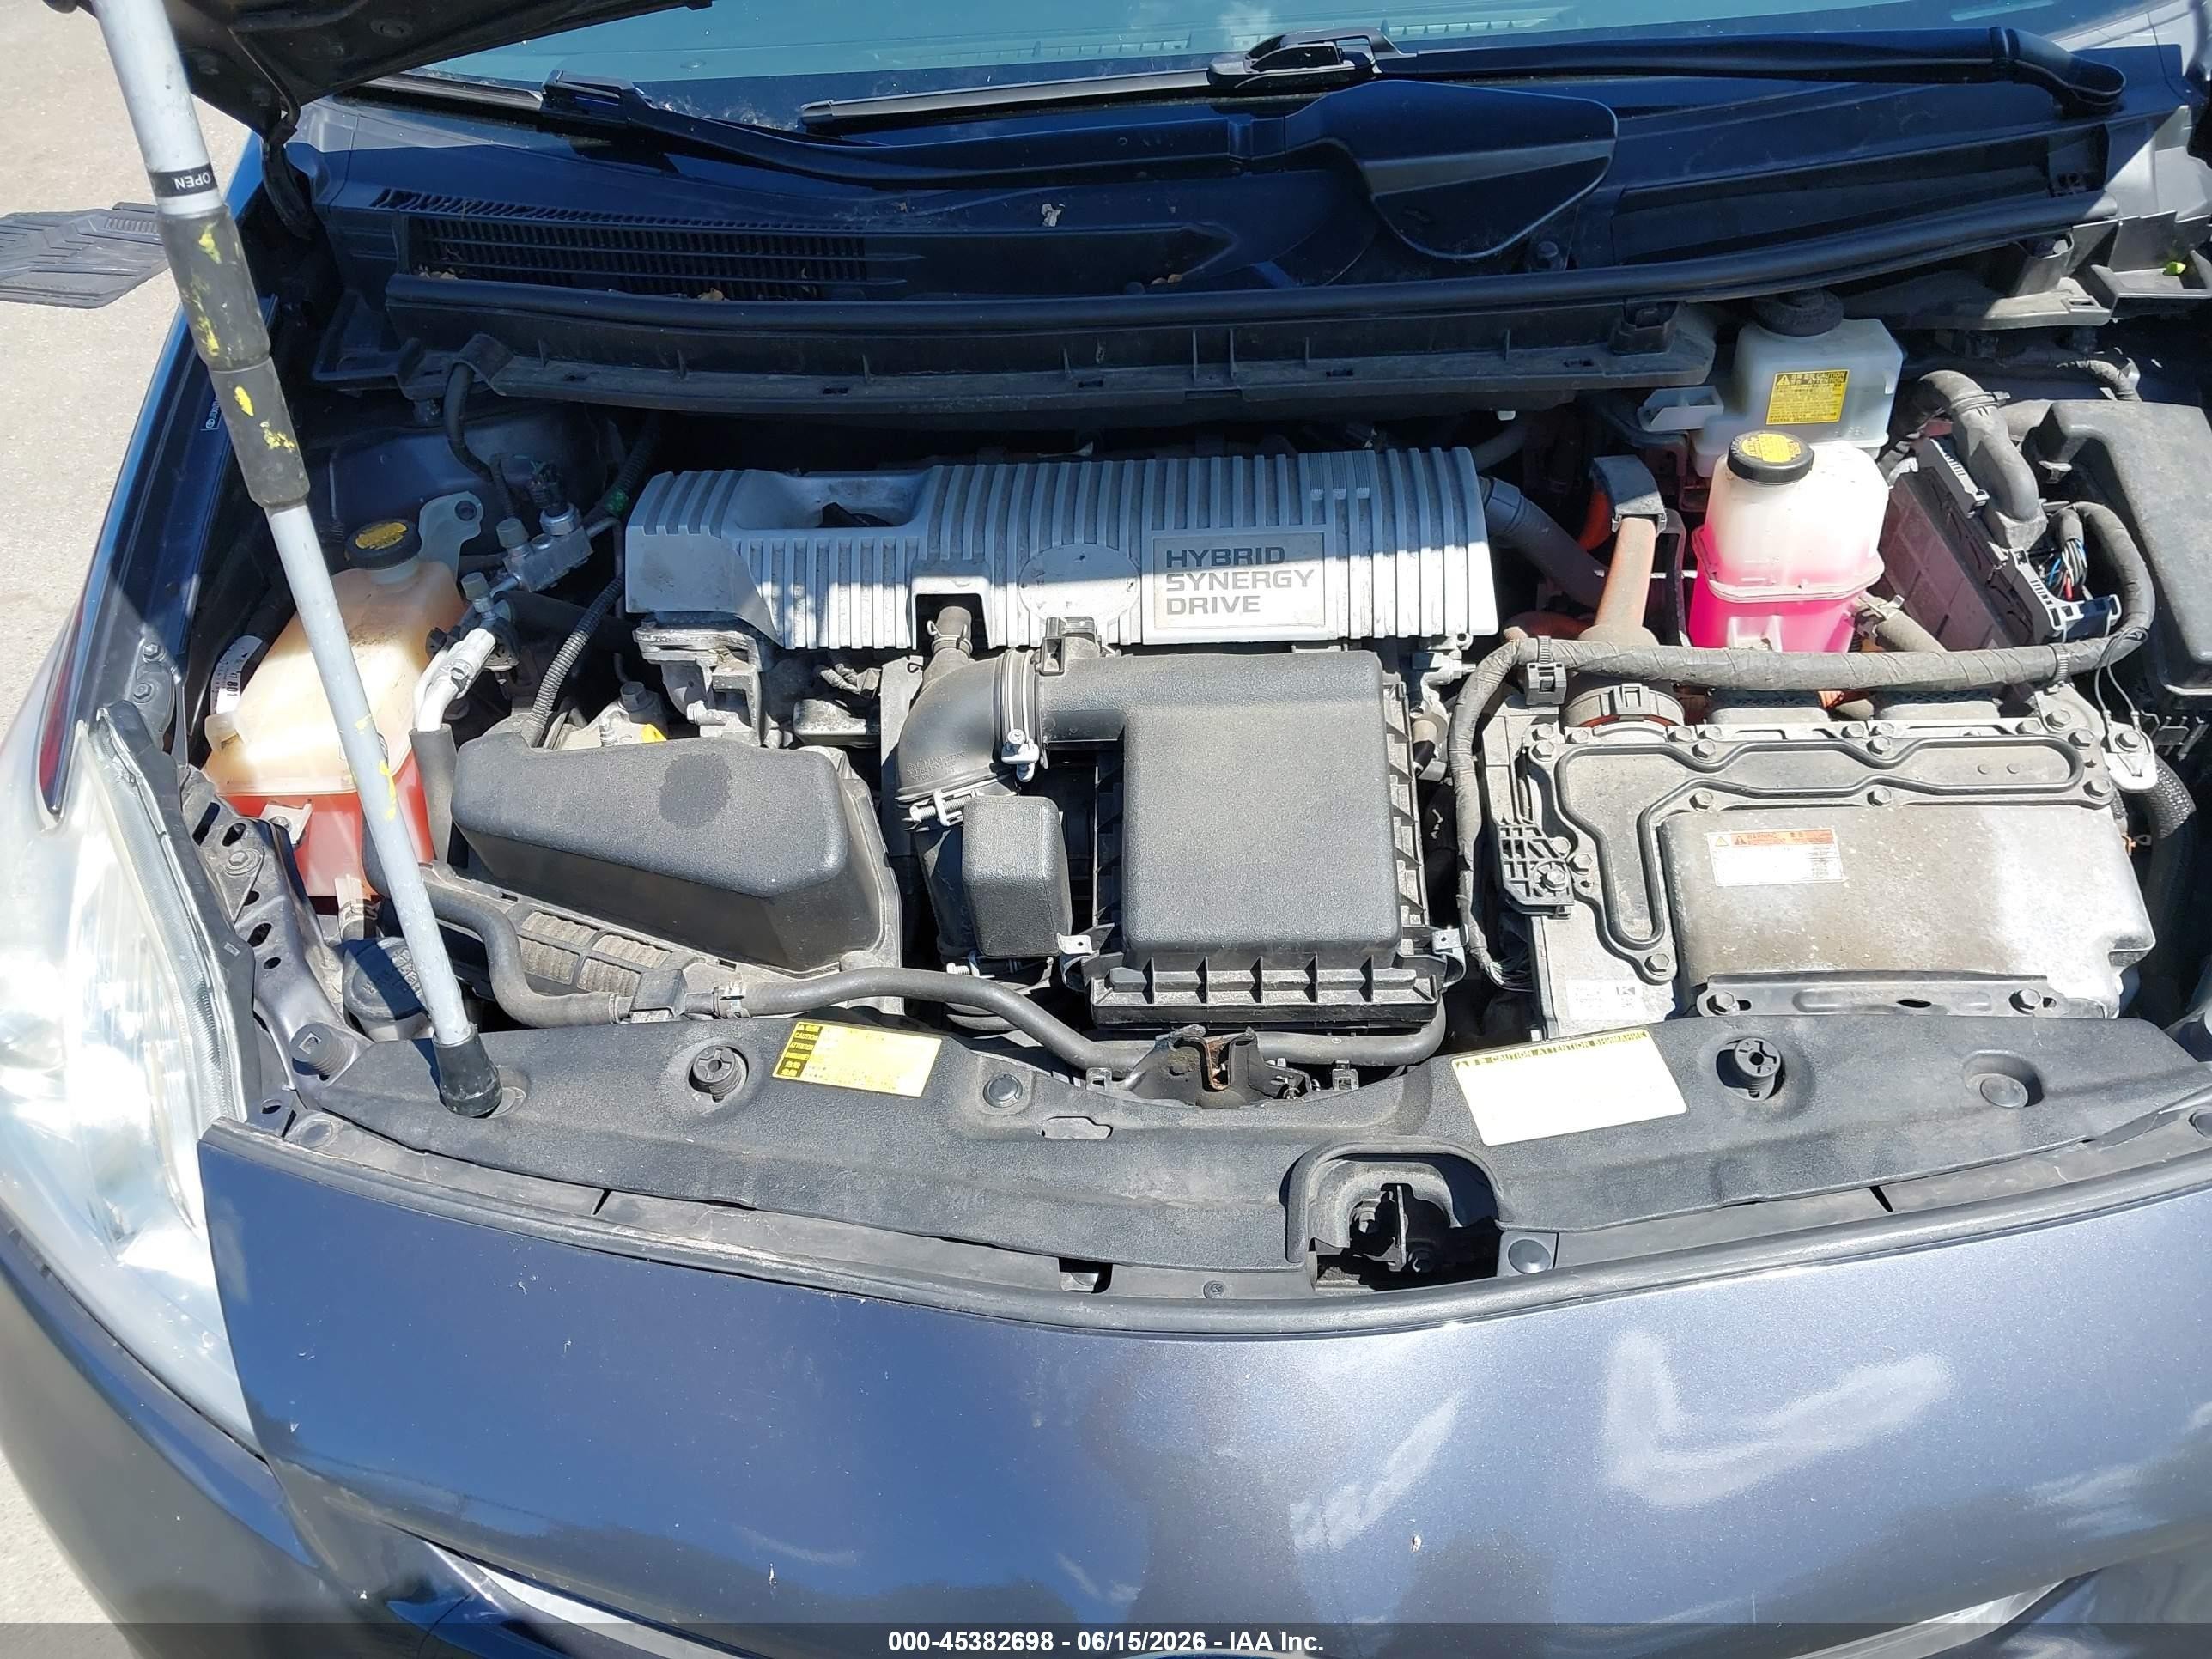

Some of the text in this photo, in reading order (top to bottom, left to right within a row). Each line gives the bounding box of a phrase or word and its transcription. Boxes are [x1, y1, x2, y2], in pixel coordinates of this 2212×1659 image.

[174, 172, 211, 190] OPEN
[1165, 546, 1285, 568] HYBRID
[1165, 569, 1315, 592] SYNERGY
[1165, 595, 1261, 616] DRIVE
[1490, 1049, 1533, 1063] CAUTION
[1537, 1040, 1589, 1055] ATTENTION
